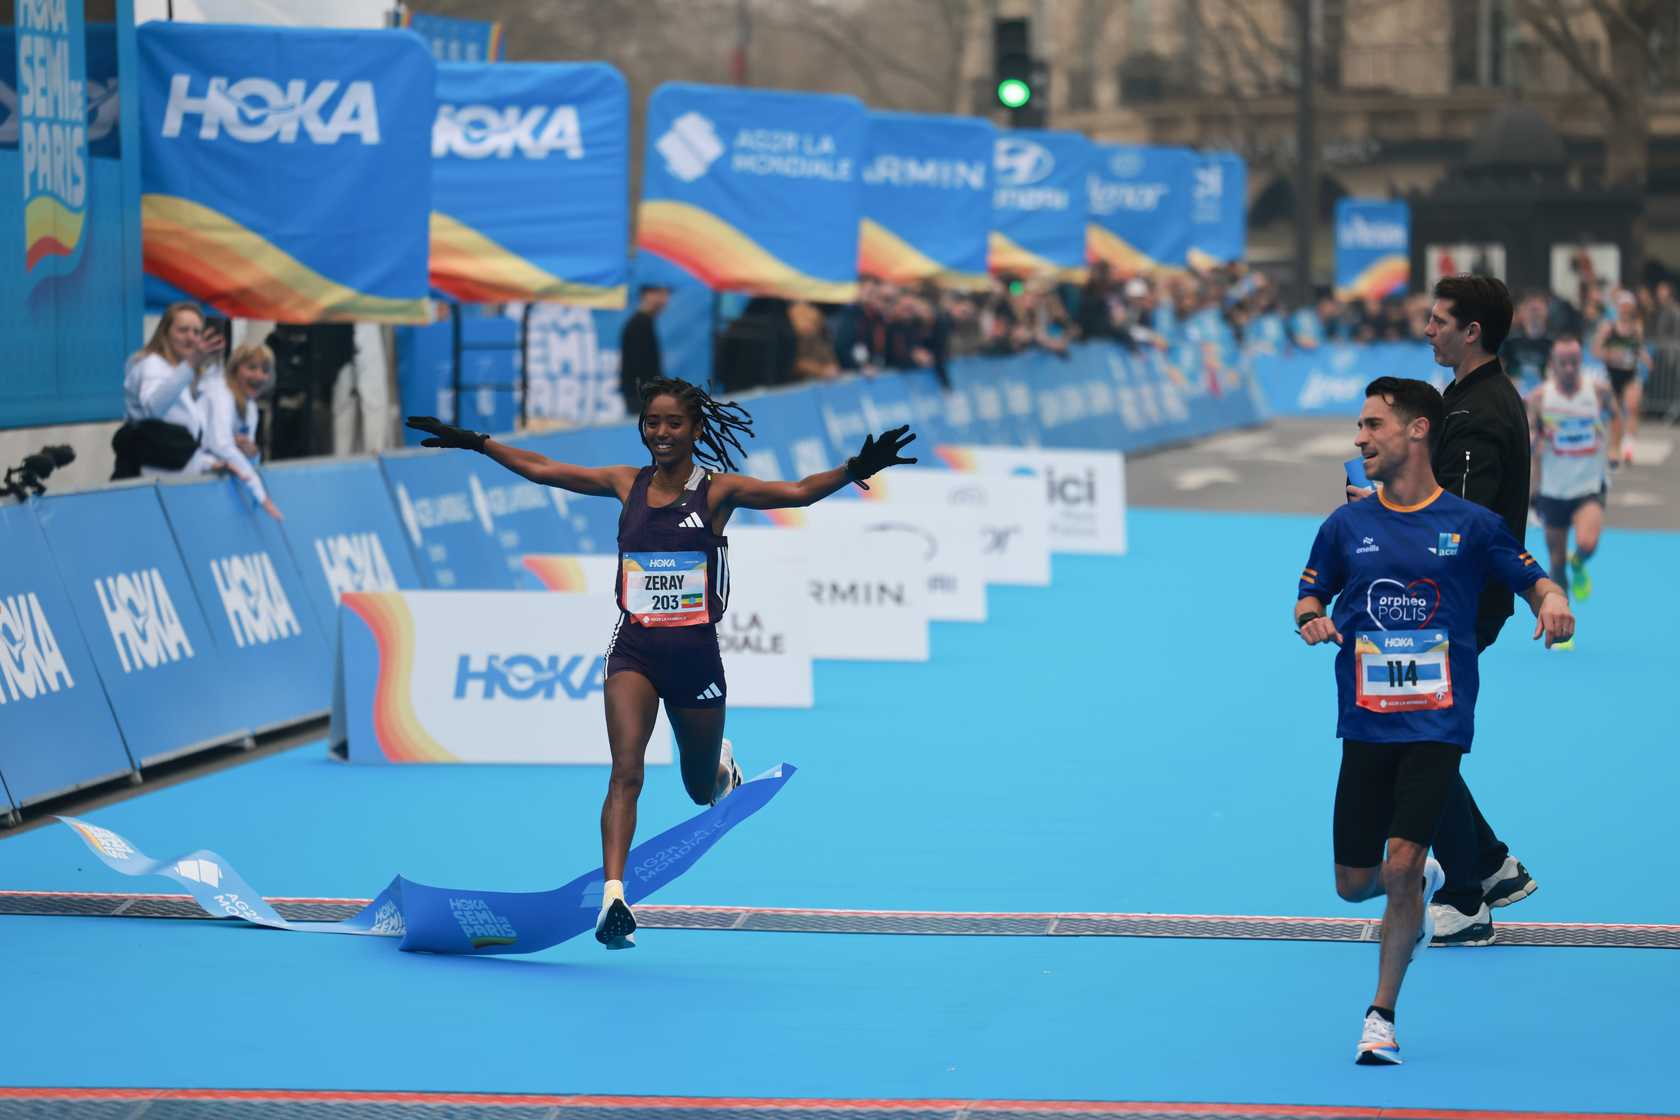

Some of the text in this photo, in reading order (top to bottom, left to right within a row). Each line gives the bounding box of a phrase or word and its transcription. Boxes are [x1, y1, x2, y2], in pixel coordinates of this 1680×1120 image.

[20, 35, 69, 119] SEMI
[162, 73, 380, 145] HOKA
[23, 122, 86, 207] PARIS
[1045, 465, 1096, 507] ici
[649, 559, 676, 568] HOKA
[645, 575, 685, 591] ZERAY
[210, 552, 301, 648] HOKA
[652, 594, 679, 610] 203
[95, 567, 194, 674] HOKA
[731, 612, 764, 632] LA
[1378, 606, 1426, 621] POLIS
[1385, 637, 1414, 648] HOKA
[453, 654, 605, 700] HOKA
[1387, 660, 1418, 687] 114
[450, 898, 489, 911] HOKA
[453, 911, 497, 925] SEMI
[461, 923, 517, 938] PARIS
